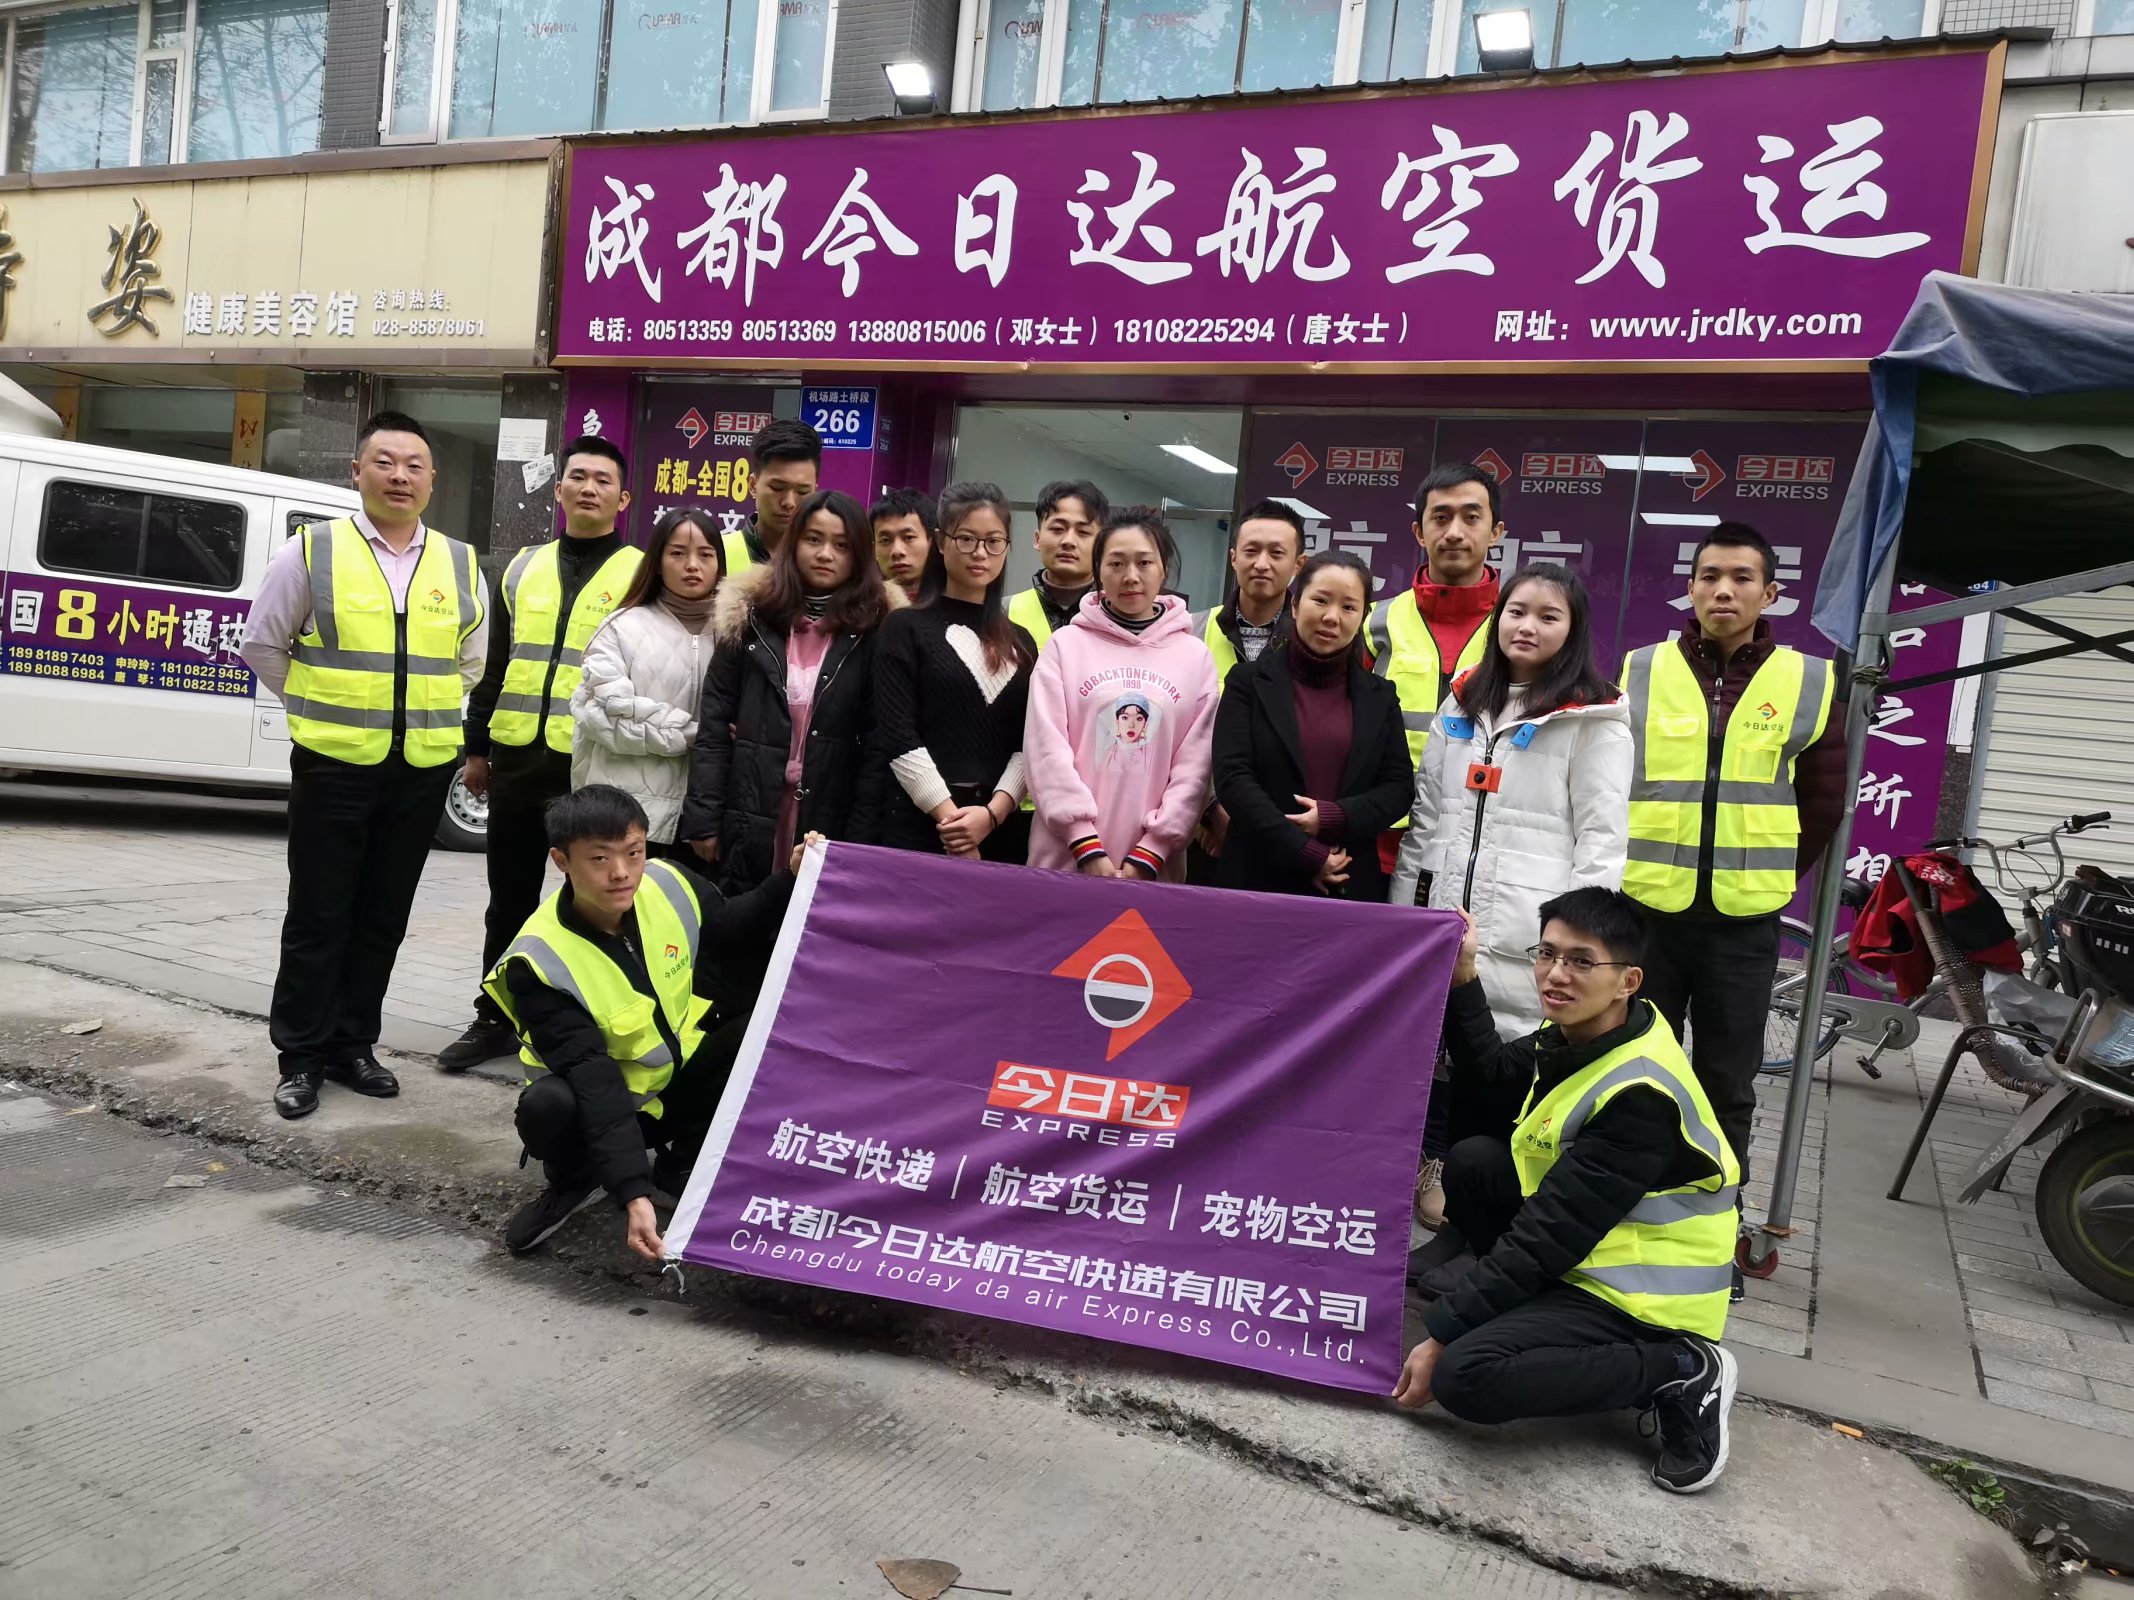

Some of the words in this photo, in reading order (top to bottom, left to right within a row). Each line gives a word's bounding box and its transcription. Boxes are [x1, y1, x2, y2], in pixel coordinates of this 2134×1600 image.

[583, 107, 1932, 306] 成都今日达航空货运
[183, 289, 359, 337] 健康美容馆
[372, 318, 486, 337] 028-85878061
[588, 317, 633, 342] 电话：
[643, 319, 733, 341] 80513359
[741, 319, 837, 342] 80513369
[1494, 309, 1569, 342] 网址：
[1590, 307, 1862, 343] www.jrdky.com
[808, 391, 870, 404] 机场路土桥段
[812, 408, 860, 433] 266
[714, 434, 753, 446] EXPRE
[1330, 450, 1399, 469] 今日达
[1525, 455, 1605, 477] 今日达
[1742, 457, 1830, 481] 今日达
[1326, 472, 1399, 487] EXPRESS
[1520, 480, 1602, 495] EXPRESS
[1735, 483, 1829, 501] EXPRESS
[0, 589, 248, 657] 国8小时通达
[71, 651, 104, 666] 7403
[71, 665, 105, 681] 6984
[218, 667, 250, 682] 9452
[217, 680, 249, 695] 5294
[997, 1064, 1181, 1127] 今日达
[980, 1109, 1177, 1150] EXPRESS
[766, 1116, 937, 1192] 航空快递
[979, 1161, 1150, 1226] 航空货运
[1200, 1190, 1377, 1256] 宠物空运
[740, 1195, 1368, 1333] 成都今日达航空快递有限公司
[730, 1229, 864, 1274] Chengdu
[875, 1259, 963, 1292] today
[974, 1278, 1011, 1300] da
[1024, 1287, 1069, 1310] air
[1081, 1295, 1212, 1337] Express
